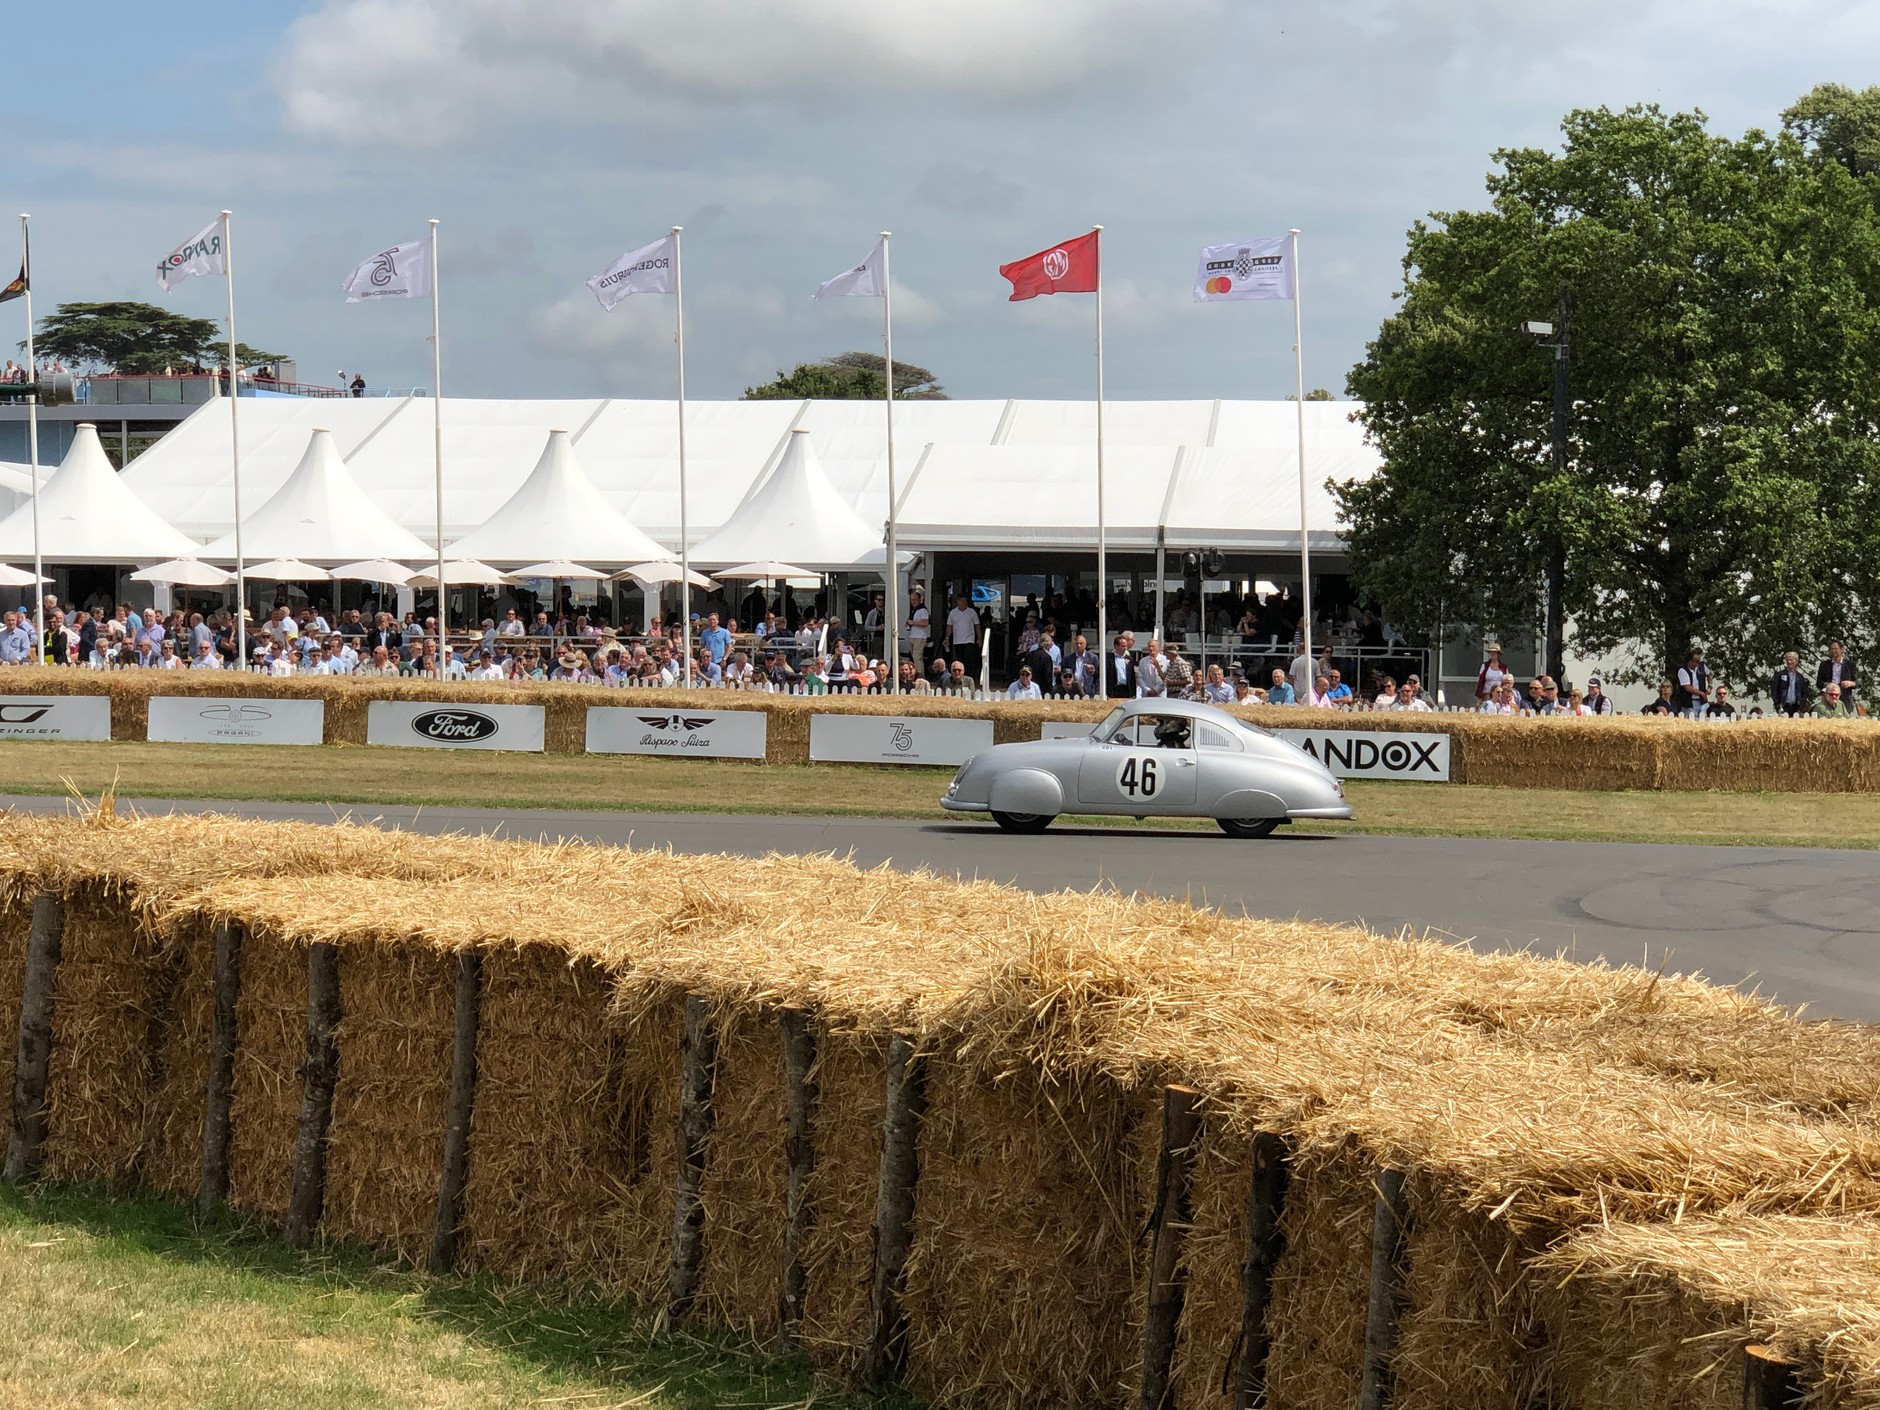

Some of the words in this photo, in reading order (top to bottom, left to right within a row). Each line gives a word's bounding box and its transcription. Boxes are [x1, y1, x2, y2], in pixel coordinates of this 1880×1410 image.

[428, 713, 481, 737] Ford
[889, 722, 913, 751] 75
[639, 733, 679, 749] Hispano
[681, 733, 711, 748] Suiza
[1120, 757, 1157, 796] 46
